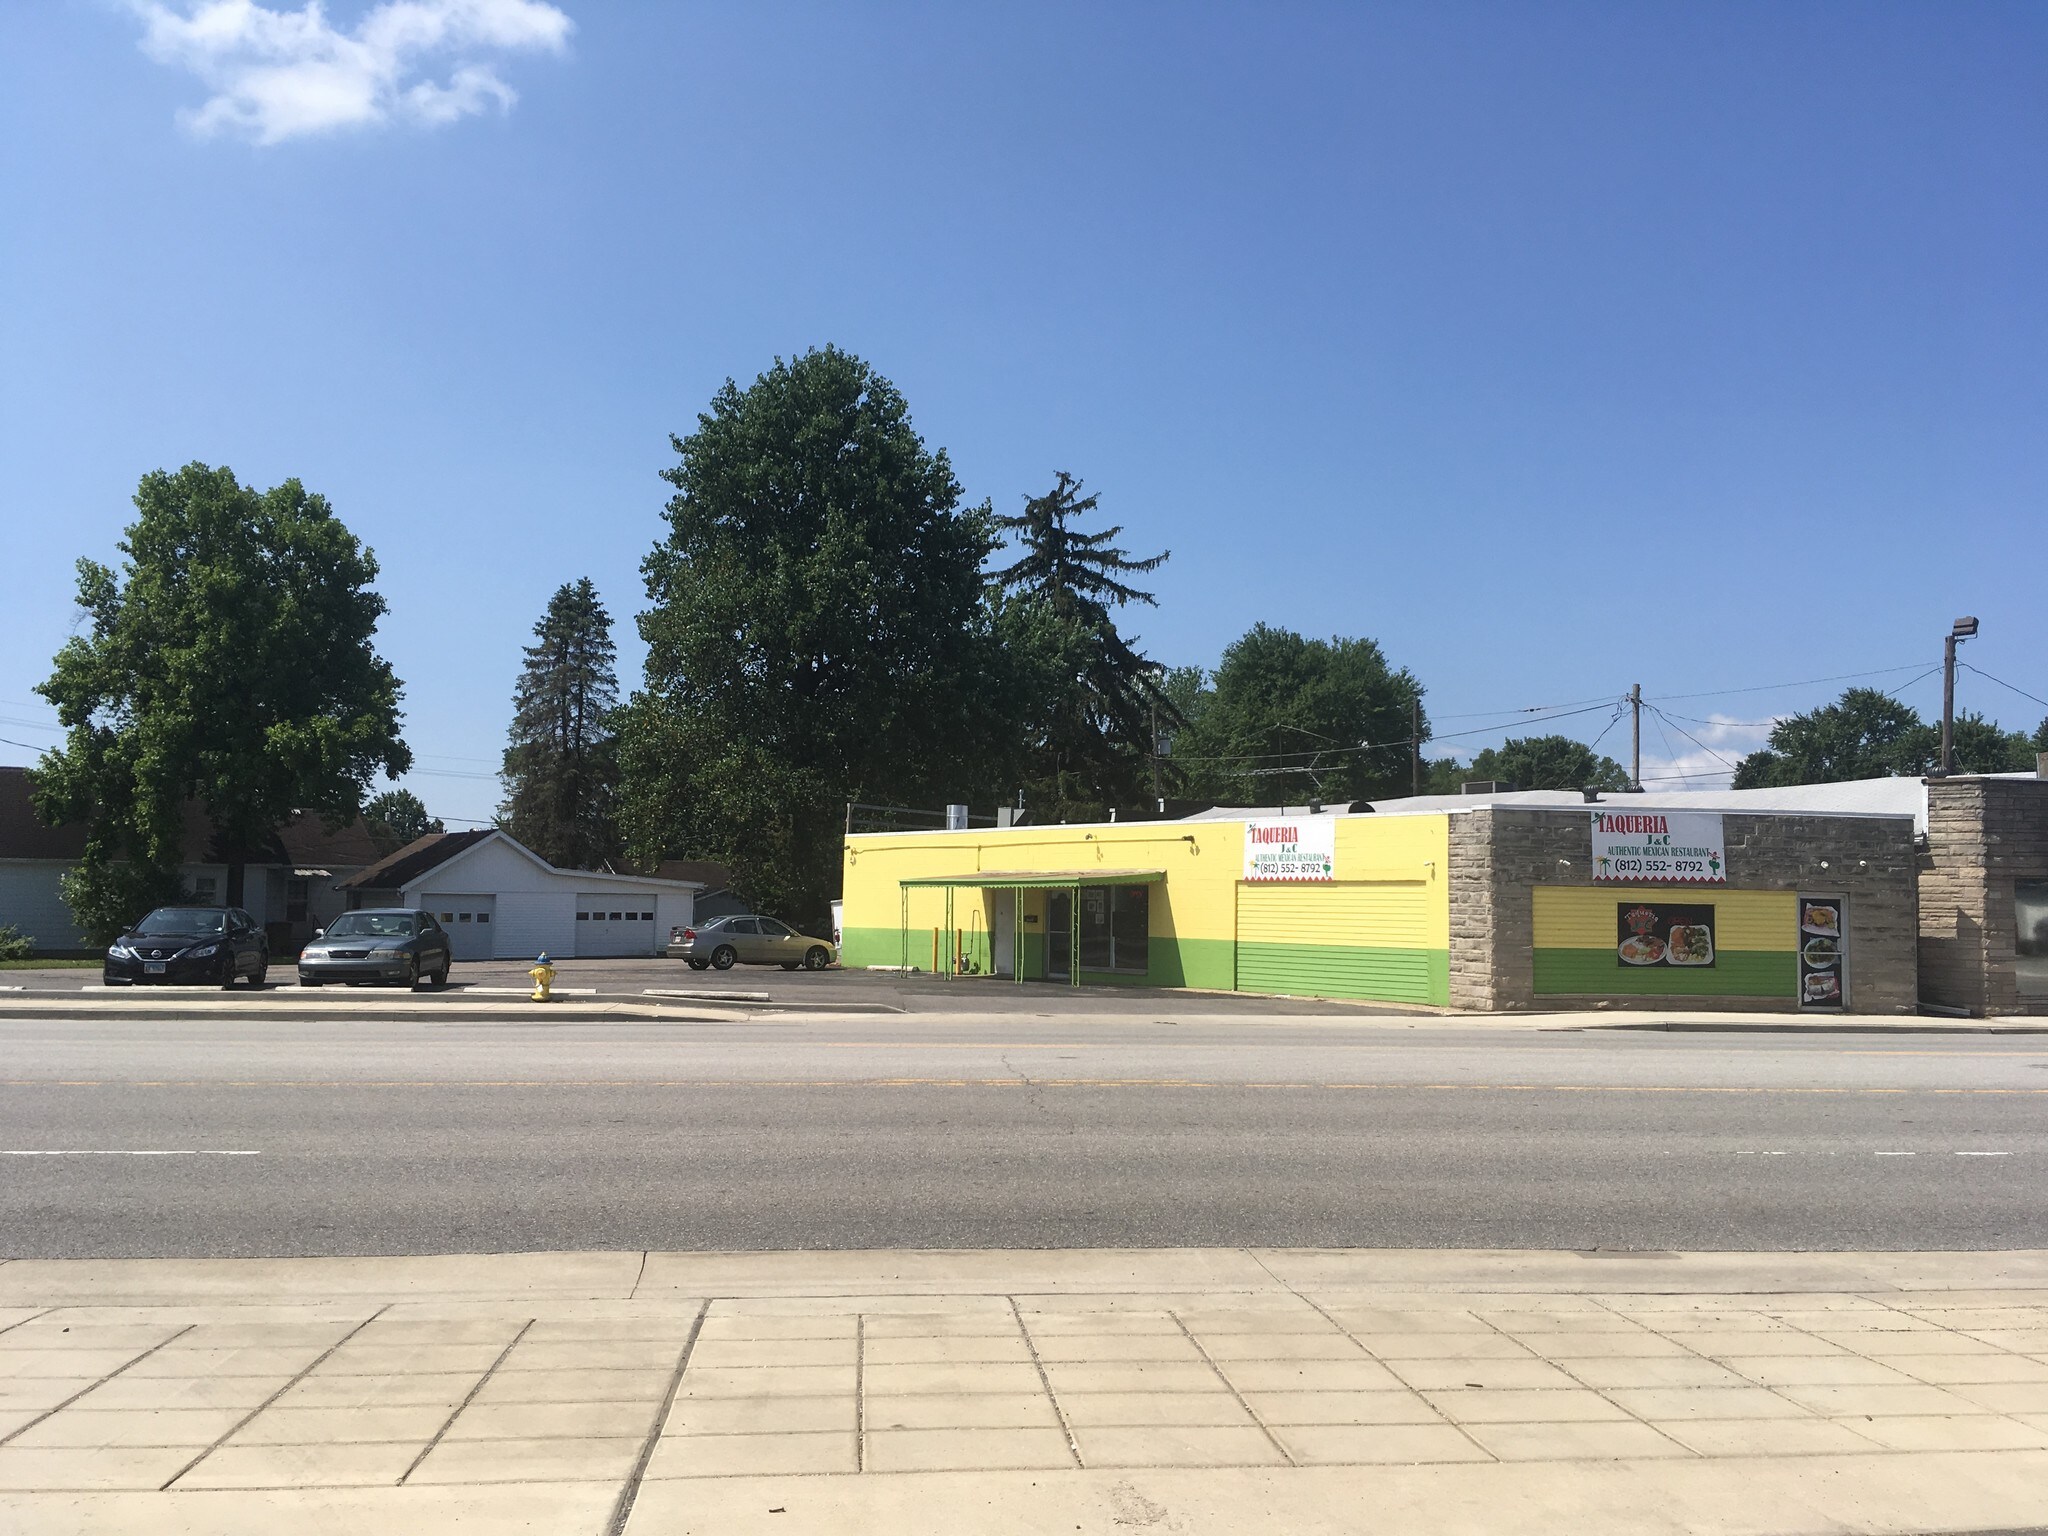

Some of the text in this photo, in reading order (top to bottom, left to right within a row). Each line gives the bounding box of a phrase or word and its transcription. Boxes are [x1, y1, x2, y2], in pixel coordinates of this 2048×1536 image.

[1599, 815, 1669, 835] TAQUERIA
[1251, 827, 1298, 844] TAQUERIA
[1646, 835, 1653, 846] J
[1662, 835, 1671, 846] C
[1281, 844, 1286, 853] J
[1292, 844, 1298, 853] C
[1608, 846, 1710, 857] AUTHENTIC MEXICAN RESTAURANT
[1260, 862, 1320, 875] (812) 552- 8792
[1615, 859, 1703, 873] (812) 552- 8792
